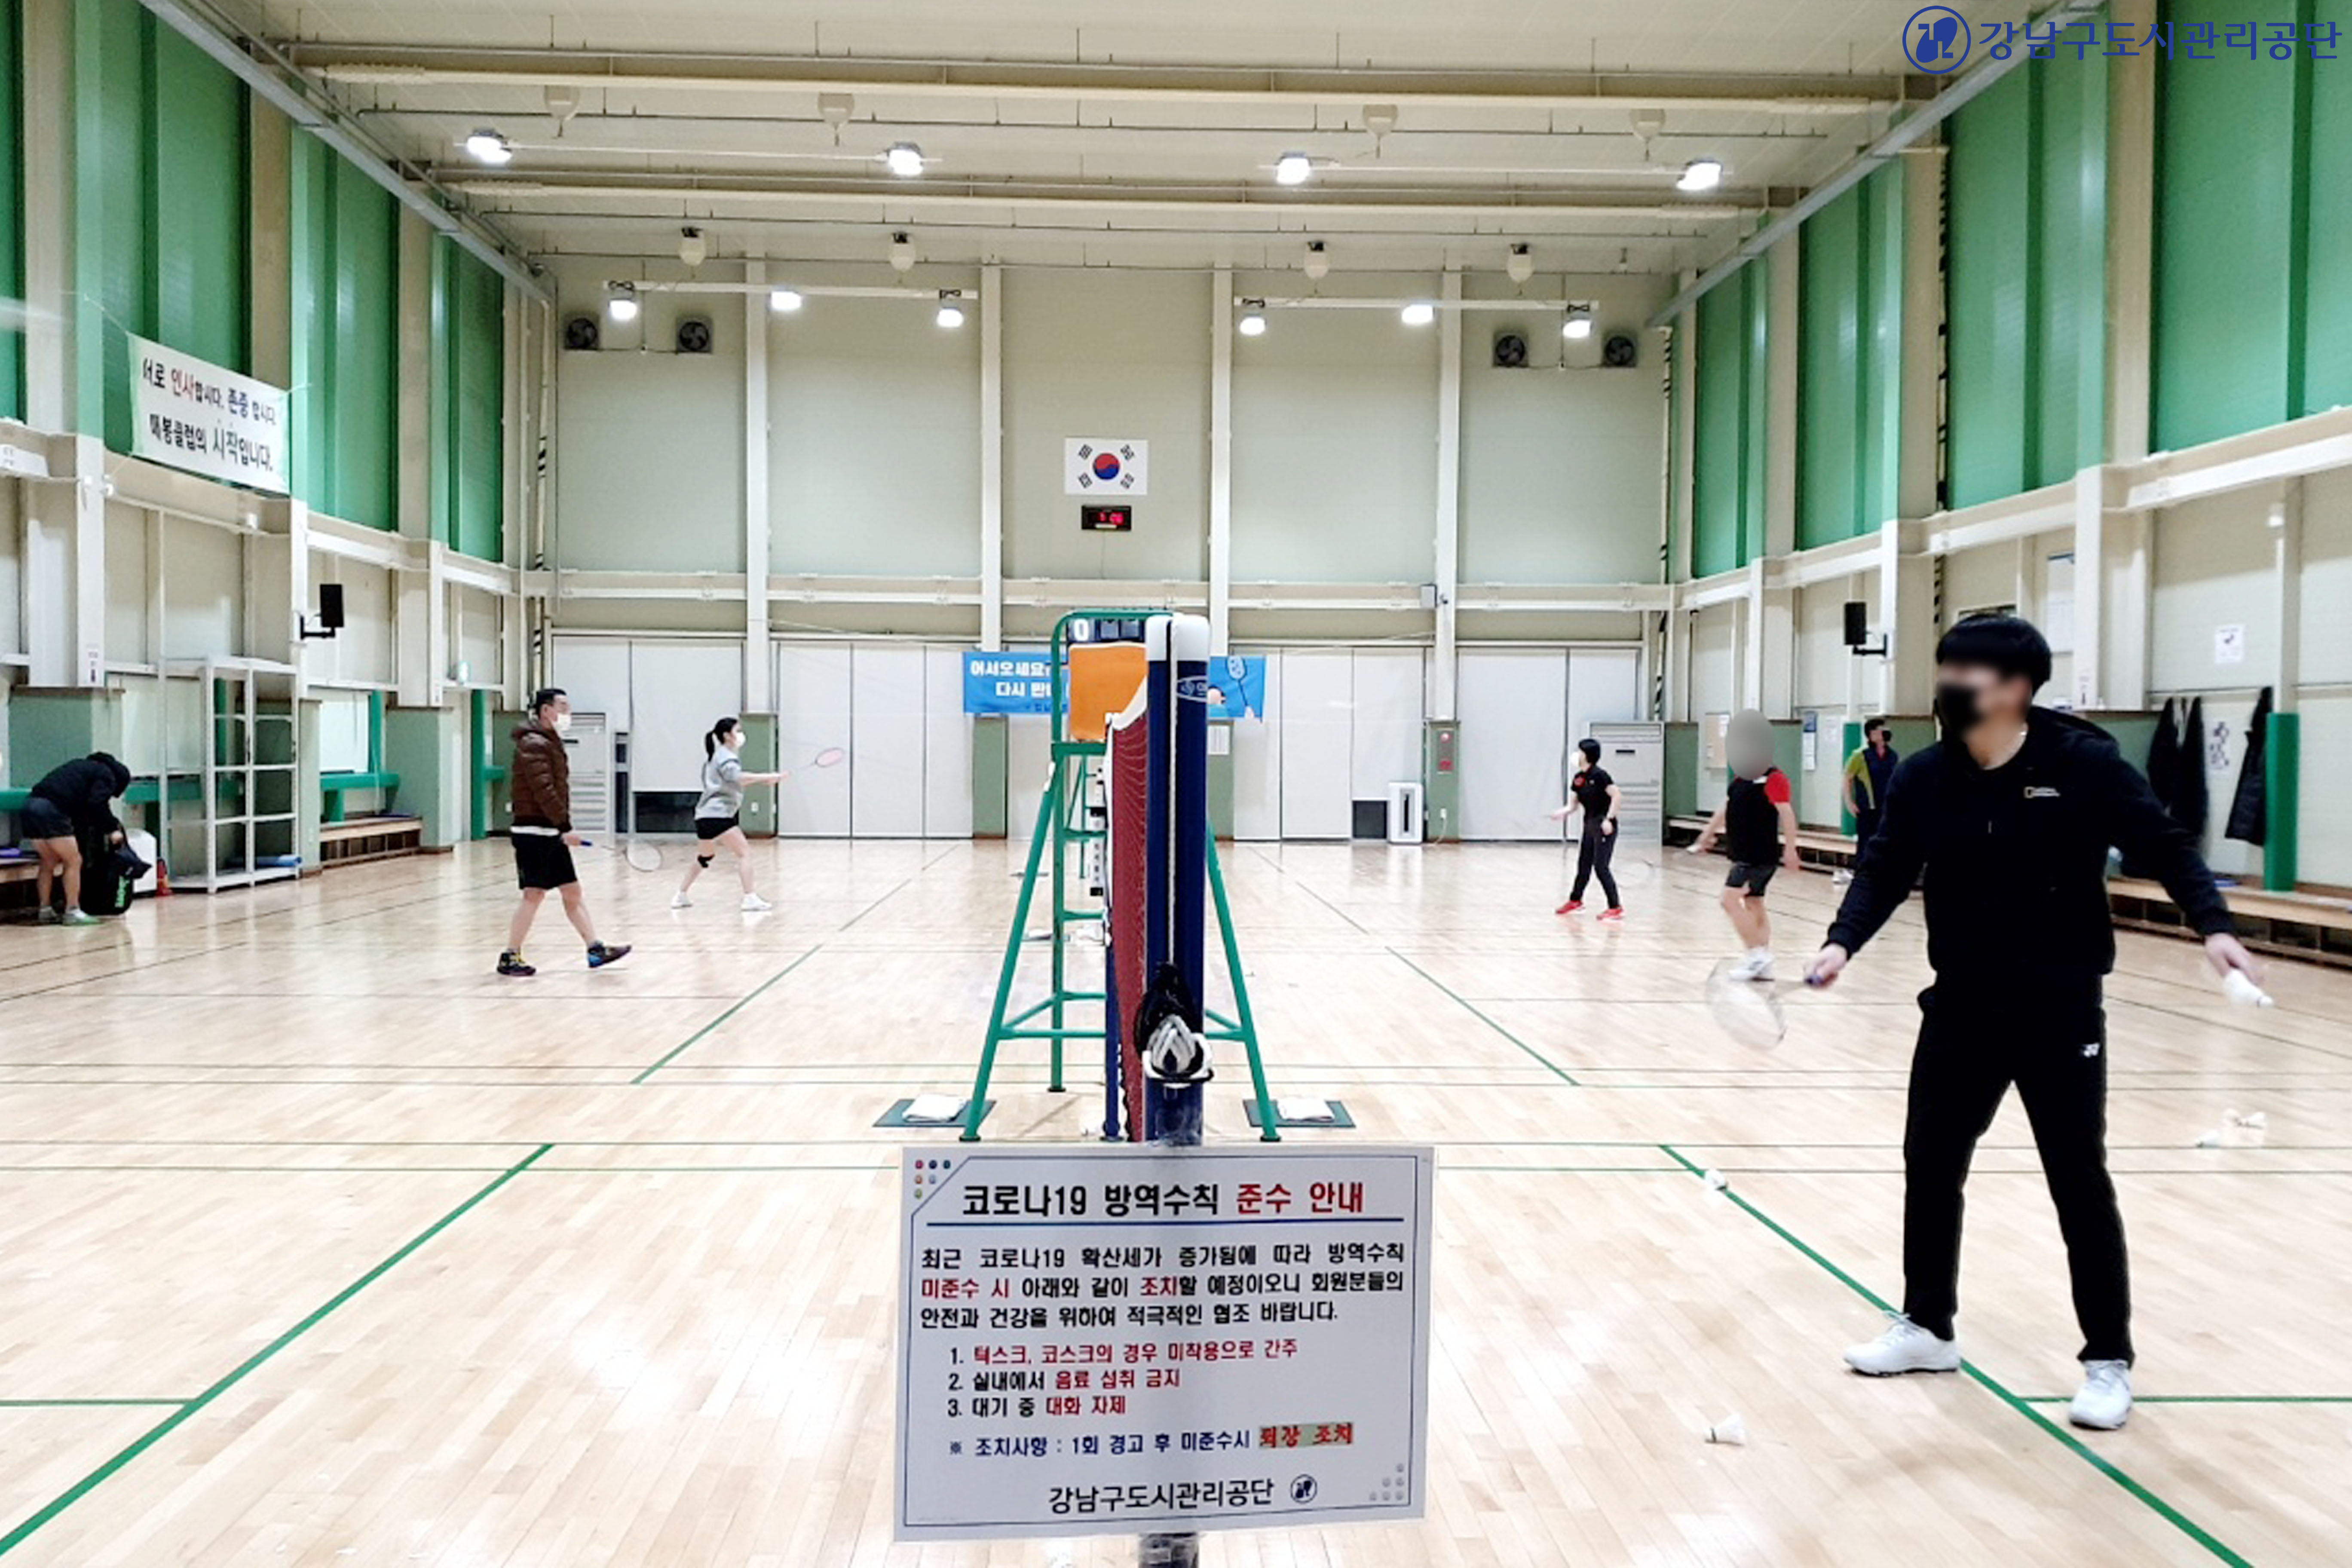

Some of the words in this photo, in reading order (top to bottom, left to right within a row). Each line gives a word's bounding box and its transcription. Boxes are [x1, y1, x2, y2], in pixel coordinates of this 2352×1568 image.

[143, 357, 165, 389] 서로
[995, 682, 1026, 697] 다시
[962, 1185, 1087, 1216] 코로나19
[1105, 1183, 1219, 1216] 방역수칙
[1236, 1183, 1292, 1215] 준수
[1309, 1182, 1363, 1213] 안내
[922, 1248, 962, 1270] 최근
[979, 1247, 1065, 1269] 코로나19
[1081, 1246, 1162, 1268] 확산세가
[1179, 1245, 1256, 1268] 증가됨에
[1273, 1243, 1311, 1265] 따라
[1328, 1242, 1404, 1264] 방역수칙
[921, 1278, 980, 1299] 미준수
[991, 1278, 1009, 1298] 시
[1022, 1277, 1080, 1298] 아래와
[1091, 1277, 1128, 1298] 같이
[1140, 1275, 1197, 1296] 조치할
[1207, 1273, 1300, 1295] 예정이오니
[1311, 1271, 1403, 1292] 회원분들의
[920, 1308, 980, 1329] 안전과
[989, 1307, 1047, 1329] 건강을
[1059, 1306, 1116, 1328] 위하여
[1127, 1304, 1202, 1326] 적극적인
[1213, 1303, 1250, 1325] 협조
[1261, 1301, 1338, 1323] 바랍니다.
[951, 1347, 964, 1365] 1.
[1041, 1344, 1112, 1363] 코스크의
[1123, 1343, 1158, 1364] 경우
[1265, 1338, 1297, 1359] 간주
[948, 1372, 964, 1391] 2.
[973, 1371, 1045, 1392] 실내에서
[1055, 1370, 1090, 1390] 음료
[1100, 1369, 1135, 1390] 섭취
[1146, 1368, 1180, 1388] 금지
[947, 1398, 962, 1418] 3.
[972, 1397, 1008, 1418] 대기
[1018, 1397, 1035, 1418] 중
[1046, 1396, 1081, 1416] 대화
[1091, 1395, 1126, 1415] 자제
[975, 1436, 1048, 1458] 조치사항
[1072, 1435, 1099, 1455] 1회
[1109, 1434, 1143, 1455] 경고
[1155, 1433, 1170, 1453] 후
[1181, 1430, 1250, 1452] 미준수시
[1313, 1422, 1353, 1444] 조치
[1049, 1478, 1274, 1513] 강남구도시관리공단
